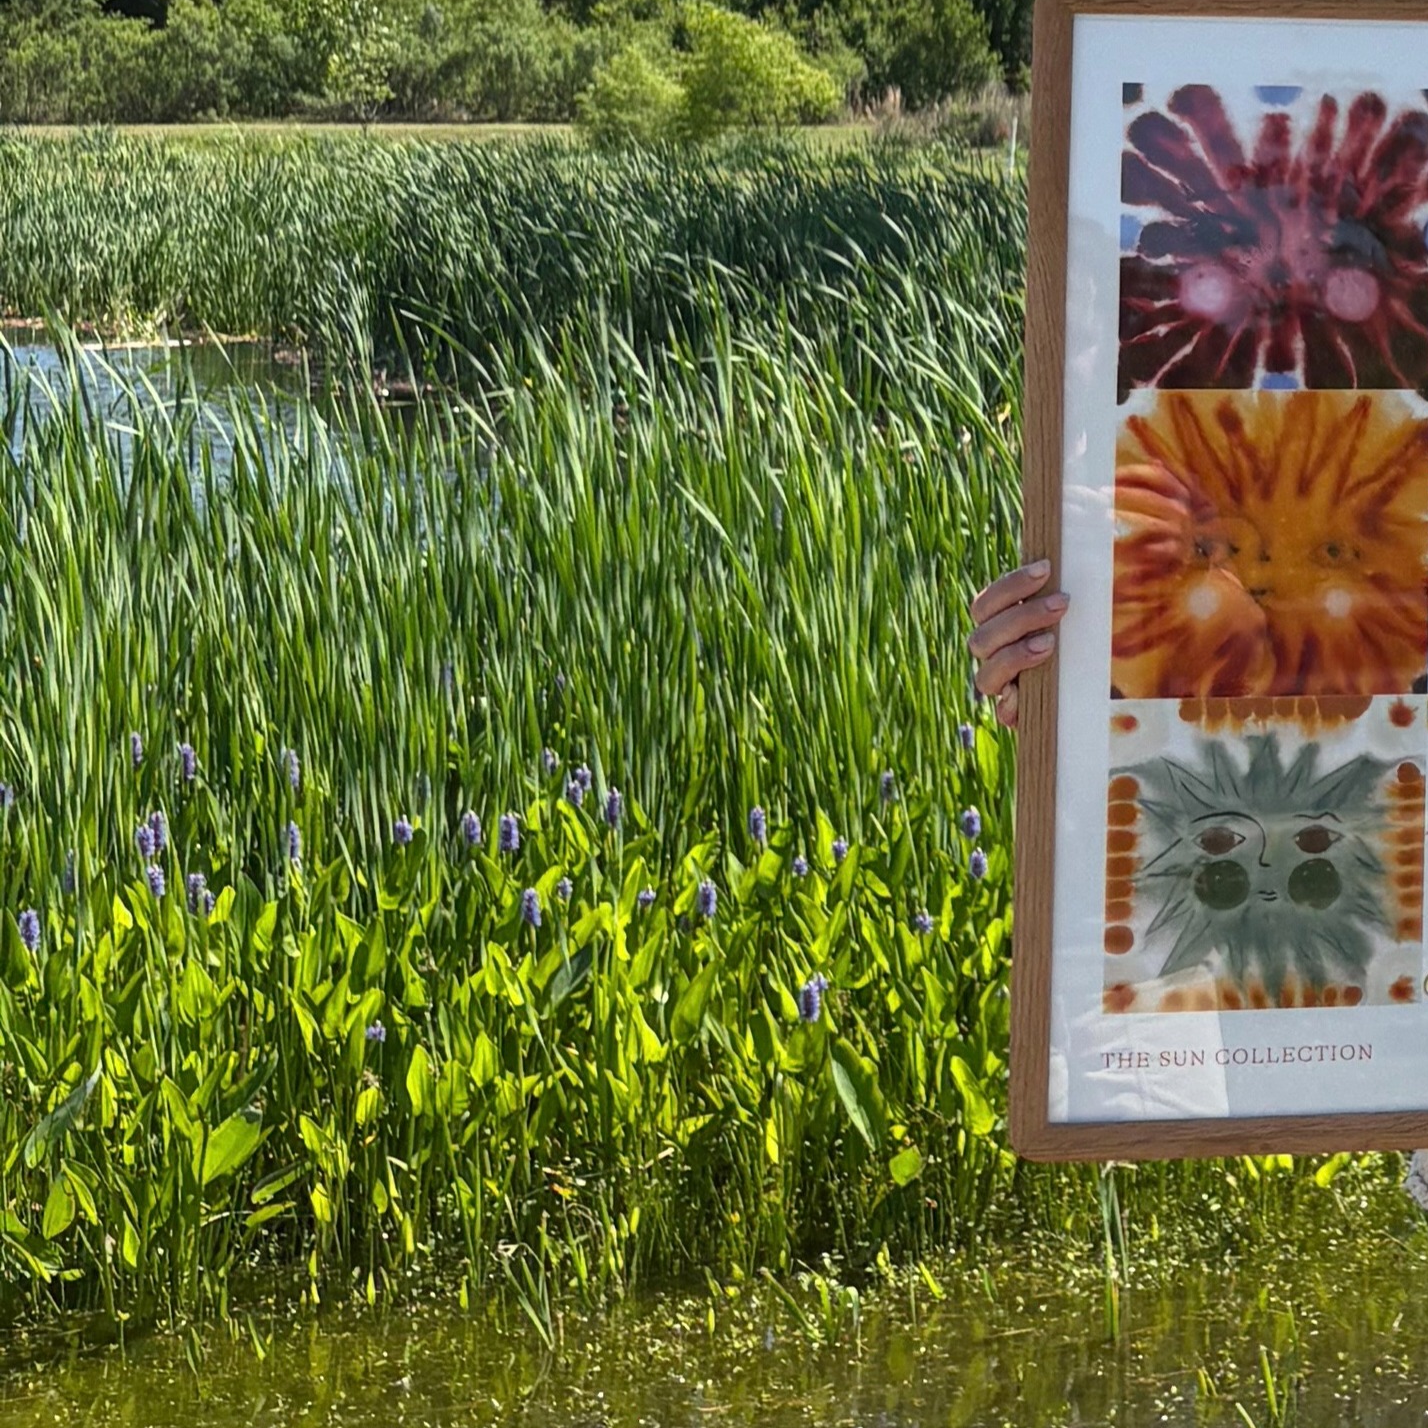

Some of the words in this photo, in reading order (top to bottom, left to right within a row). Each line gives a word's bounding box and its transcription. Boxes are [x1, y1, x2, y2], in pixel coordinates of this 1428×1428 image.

[1101, 1051, 1151, 1069] THE
[1159, 1049, 1205, 1068] SUN
[1215, 1043, 1373, 1066] COLLECTION
